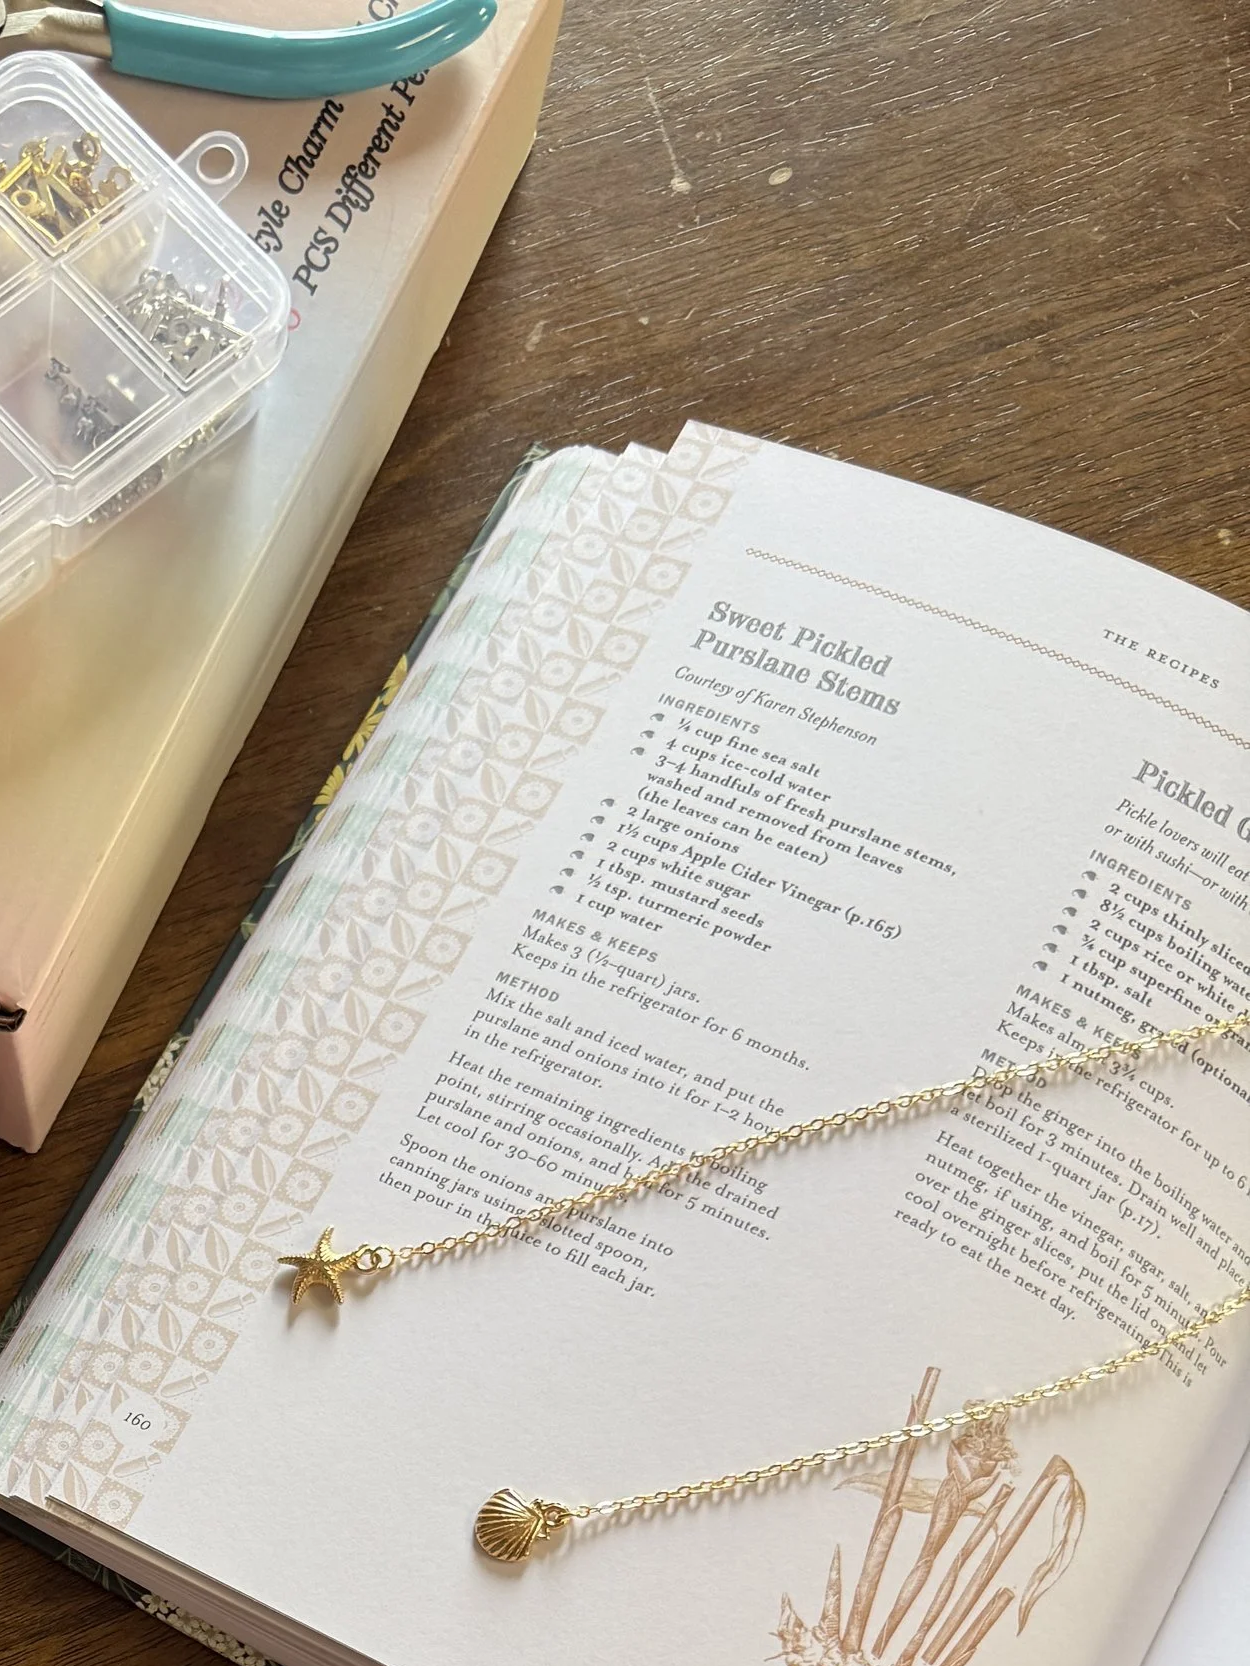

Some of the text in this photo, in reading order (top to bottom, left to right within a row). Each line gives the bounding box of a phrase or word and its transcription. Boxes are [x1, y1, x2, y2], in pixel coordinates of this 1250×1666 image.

[247, 100, 344, 254] tyle Charm
[293, 228, 339, 296] PCS
[325, 102, 406, 233] Different
[689, 627, 901, 715] Purslane Stems
[706, 600, 893, 677] Sweet Pickled
[1102, 628, 1220, 689] THE RECIPES
[657, 692, 760, 734] INGREDIENTS
[674, 665, 877, 746] Courtesy of Karen Stephenson
[665, 737, 831, 802] 4 cups ice-cold water
[694, 727, 723, 746] cup
[725, 734, 759, 756] fine
[760, 750, 787, 766] sea
[789, 761, 820, 778] salt
[637, 784, 829, 866] (the leaves can be eaten)
[647, 772, 904, 874] washed and removed from leaves
[688, 762, 761, 798] handfuls
[763, 792, 786, 805] of
[783, 796, 825, 823] fresh
[825, 817, 901, 852] purslane
[903, 847, 956, 877] stems,
[1131, 758, 1234, 828] Pickled
[625, 805, 740, 853] 2 large onions
[1114, 797, 1158, 829] Pickle
[1157, 819, 1200, 852] lovers
[1199, 846, 1230, 868] will
[595, 857, 764, 928] 1 tbsp. mustard seeds
[605, 840, 751, 900] 2 cups white sugar
[641, 834, 679, 853] cups
[678, 844, 727, 870] Apple
[730, 861, 777, 888] Cider
[781, 878, 842, 914] Vinegar
[844, 905, 902, 940] (p.165)
[1088, 848, 1192, 911] INGREDIENTS
[1103, 824, 1123, 836] or
[1122, 832, 1154, 855] with
[1218, 886, 1248, 911] with
[531, 908, 658, 963] MAKES & KEEPS
[574, 893, 663, 932] 1 cup water
[603, 882, 631, 901] tsp.
[637, 894, 710, 929] turmeric
[709, 924, 772, 952] powder
[1107, 882, 1121, 896] 2
[1123, 892, 1160, 916] cups
[1162, 911, 1210, 948] thinly
[521, 924, 569, 952] Makes
[569, 945, 583, 959] 3
[662, 980, 700, 1003] jars.
[1068, 954, 1152, 1008] 1 tbsp. salt
[1088, 918, 1235, 1013] 2 cups rice or white
[1097, 948, 1127, 971] cup
[1128, 965, 1202, 1015] superfine
[1127, 917, 1164, 942] cups
[1165, 934, 1222, 982] boiling
[494, 970, 560, 1002] METHOD
[510, 941, 809, 1071] Keeps in the refrigerator for 6 months.
[463, 1023, 602, 1088] in the refrigerator.
[484, 986, 784, 1117] Mix the salt and iced water, and put the
[949, 1106, 1161, 1239] a sterilized 1-quart jar (p.17).
[934, 1129, 1191, 1305] Heat together the vinegar, sugar, salt,
[893, 1209, 1075, 1320] ready to eat the next day.
[123, 1412, 152, 1431] 160
